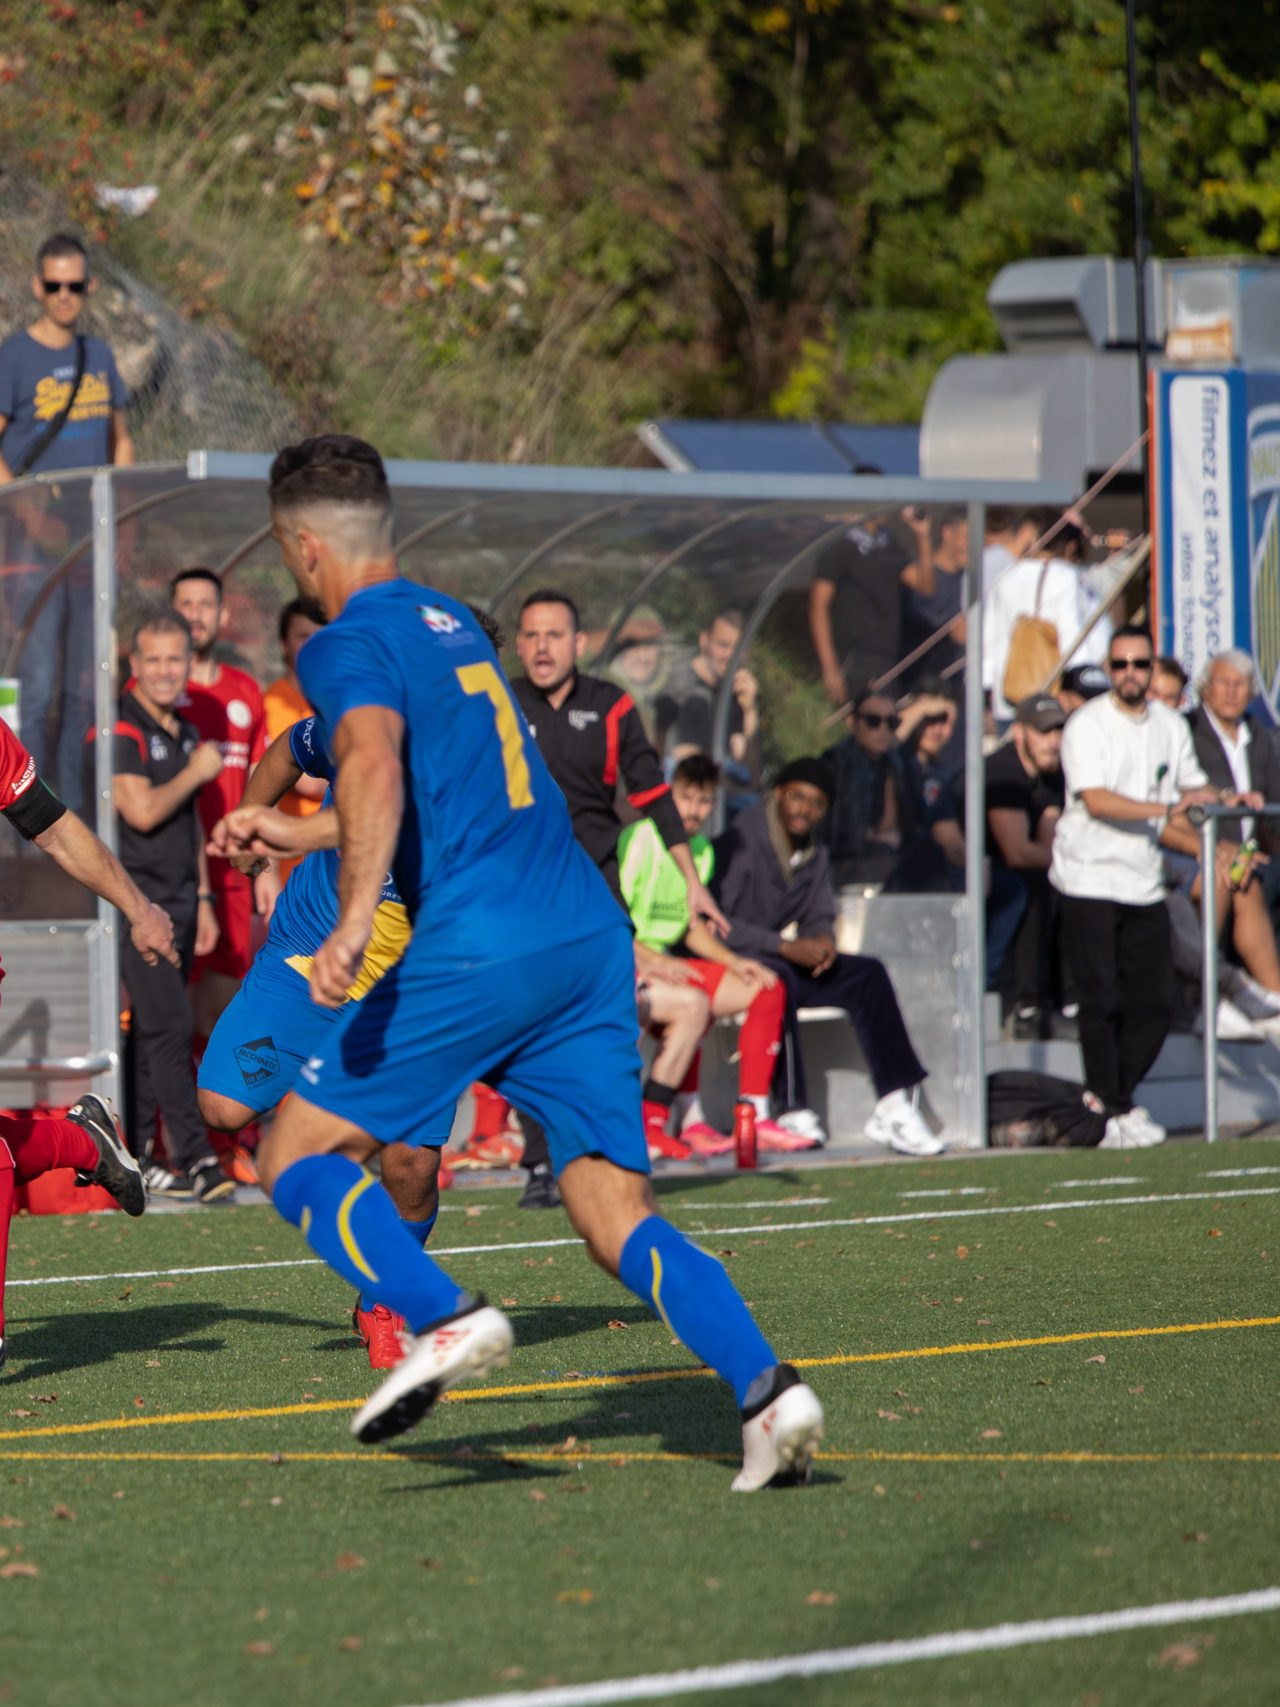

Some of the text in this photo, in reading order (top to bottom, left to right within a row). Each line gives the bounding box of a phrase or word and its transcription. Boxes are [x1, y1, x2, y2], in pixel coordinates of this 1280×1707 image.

[1201, 384, 1219, 480] filmez
[1203, 487, 1220, 520] et
[455, 661, 536, 809] 7
